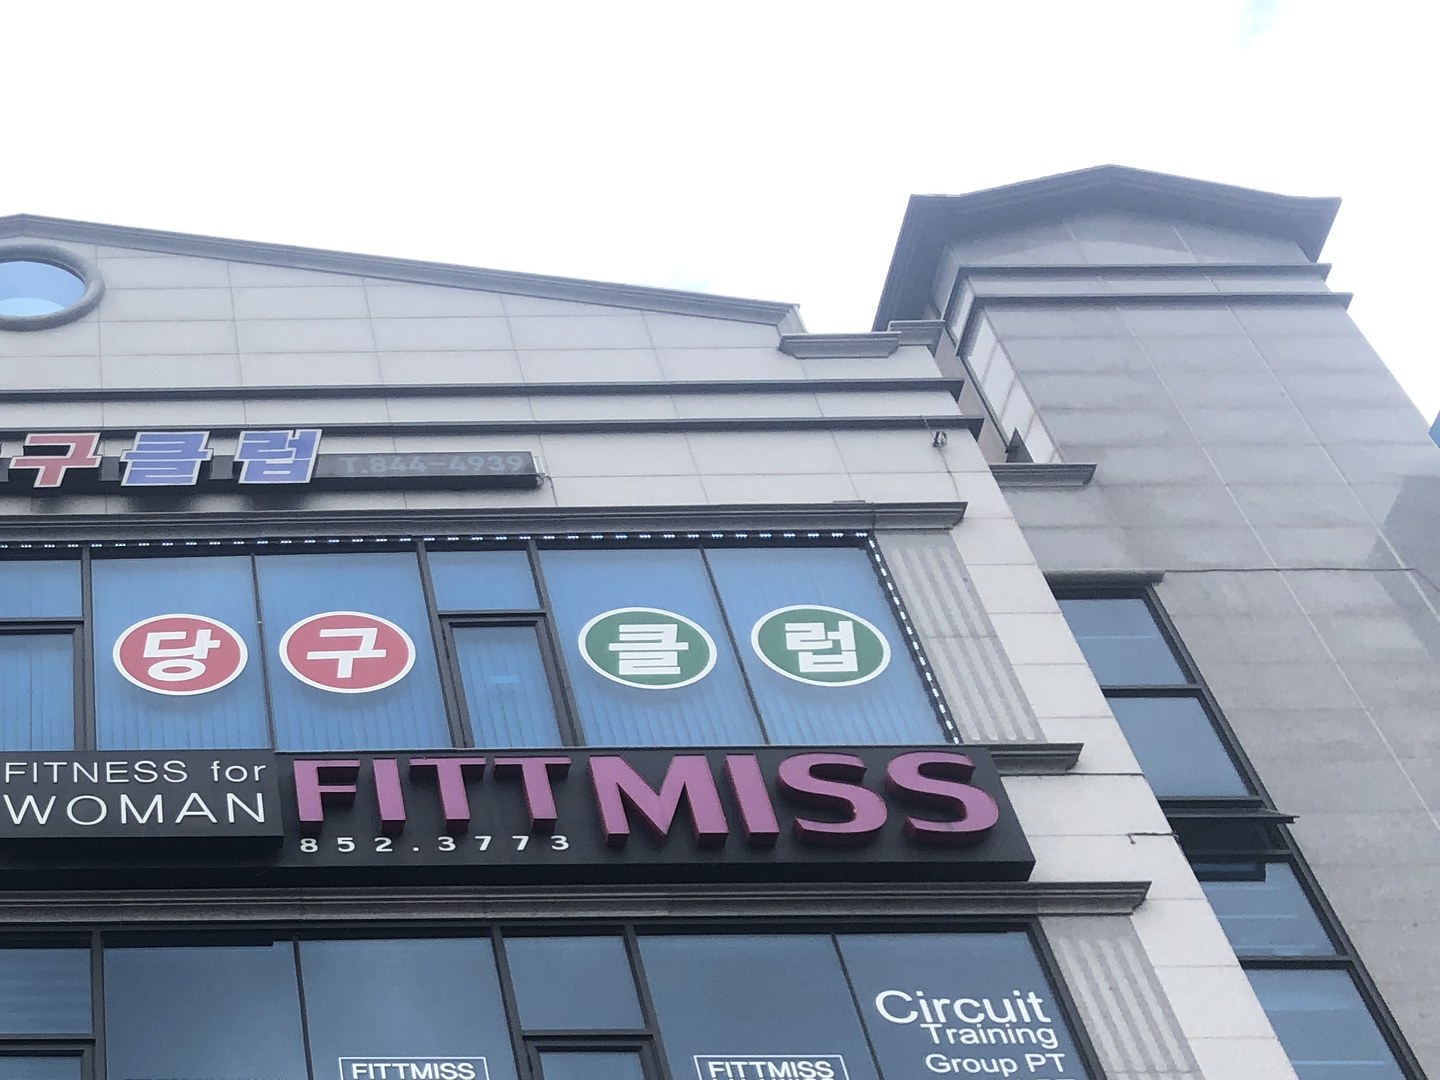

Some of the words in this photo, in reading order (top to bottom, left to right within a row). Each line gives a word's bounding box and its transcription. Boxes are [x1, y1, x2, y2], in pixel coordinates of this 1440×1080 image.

[5, 760, 188, 783] FITNESS
[211, 760, 267, 783] for
[3, 793, 266, 826] WOMAN
[293, 752, 1001, 847] FITTMISS
[300, 836, 572, 854] 852.3773
[875, 989, 1052, 1024] Circuit
[920, 1024, 1058, 1049] Training
[351, 1062, 476, 1080] FITTMISS
[708, 1061, 835, 1079] FITTMISS
[925, 1053, 1017, 1076] Group
[1025, 1053, 1065, 1072] PT
